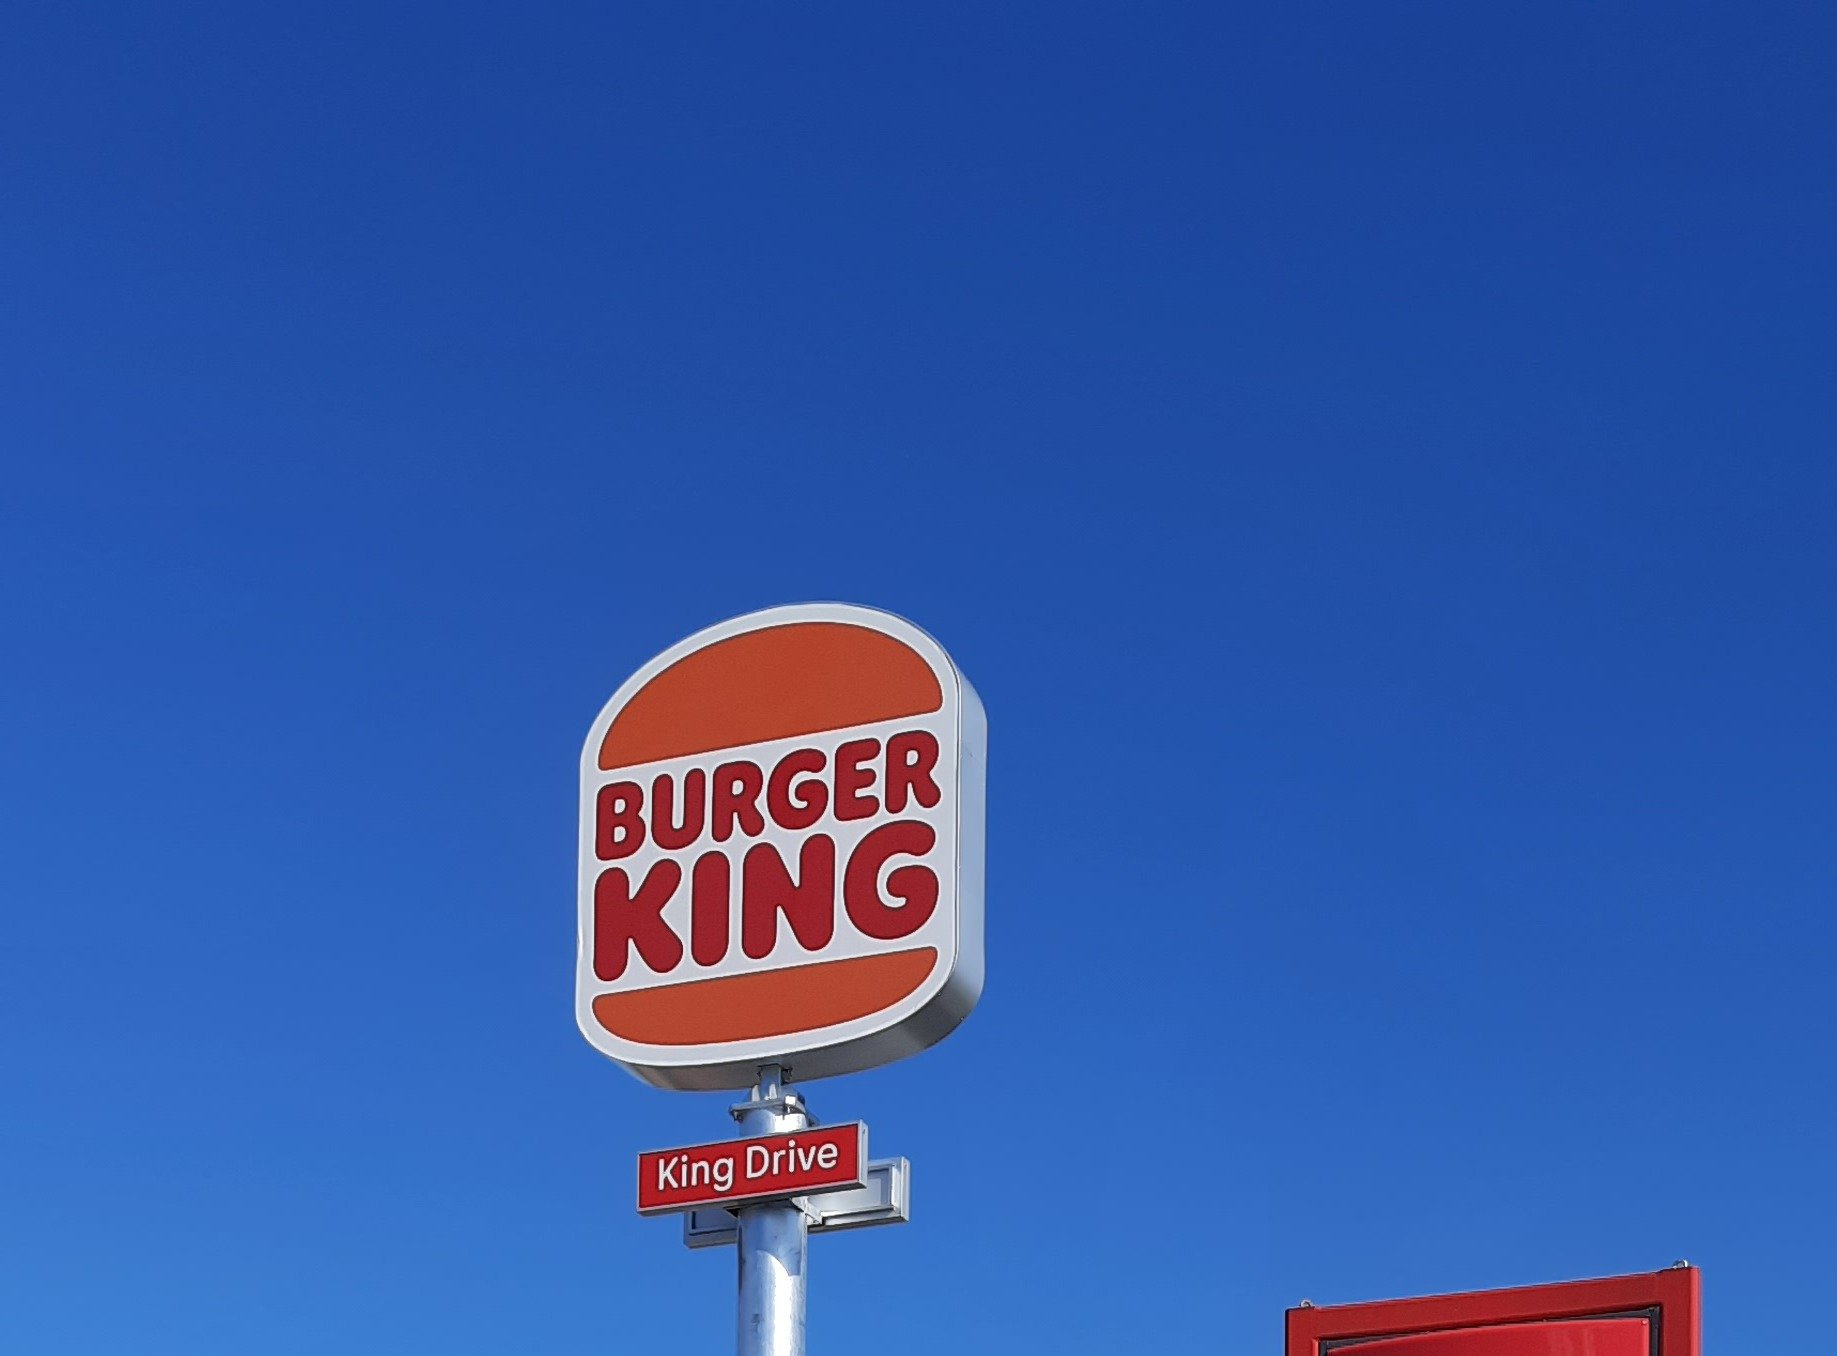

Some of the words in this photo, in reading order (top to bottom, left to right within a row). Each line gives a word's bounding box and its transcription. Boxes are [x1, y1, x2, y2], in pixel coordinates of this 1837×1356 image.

[595, 730, 941, 861] BURGER
[594, 820, 939, 981] KING
[658, 1154, 734, 1192] King
[746, 1139, 838, 1179] Drive
